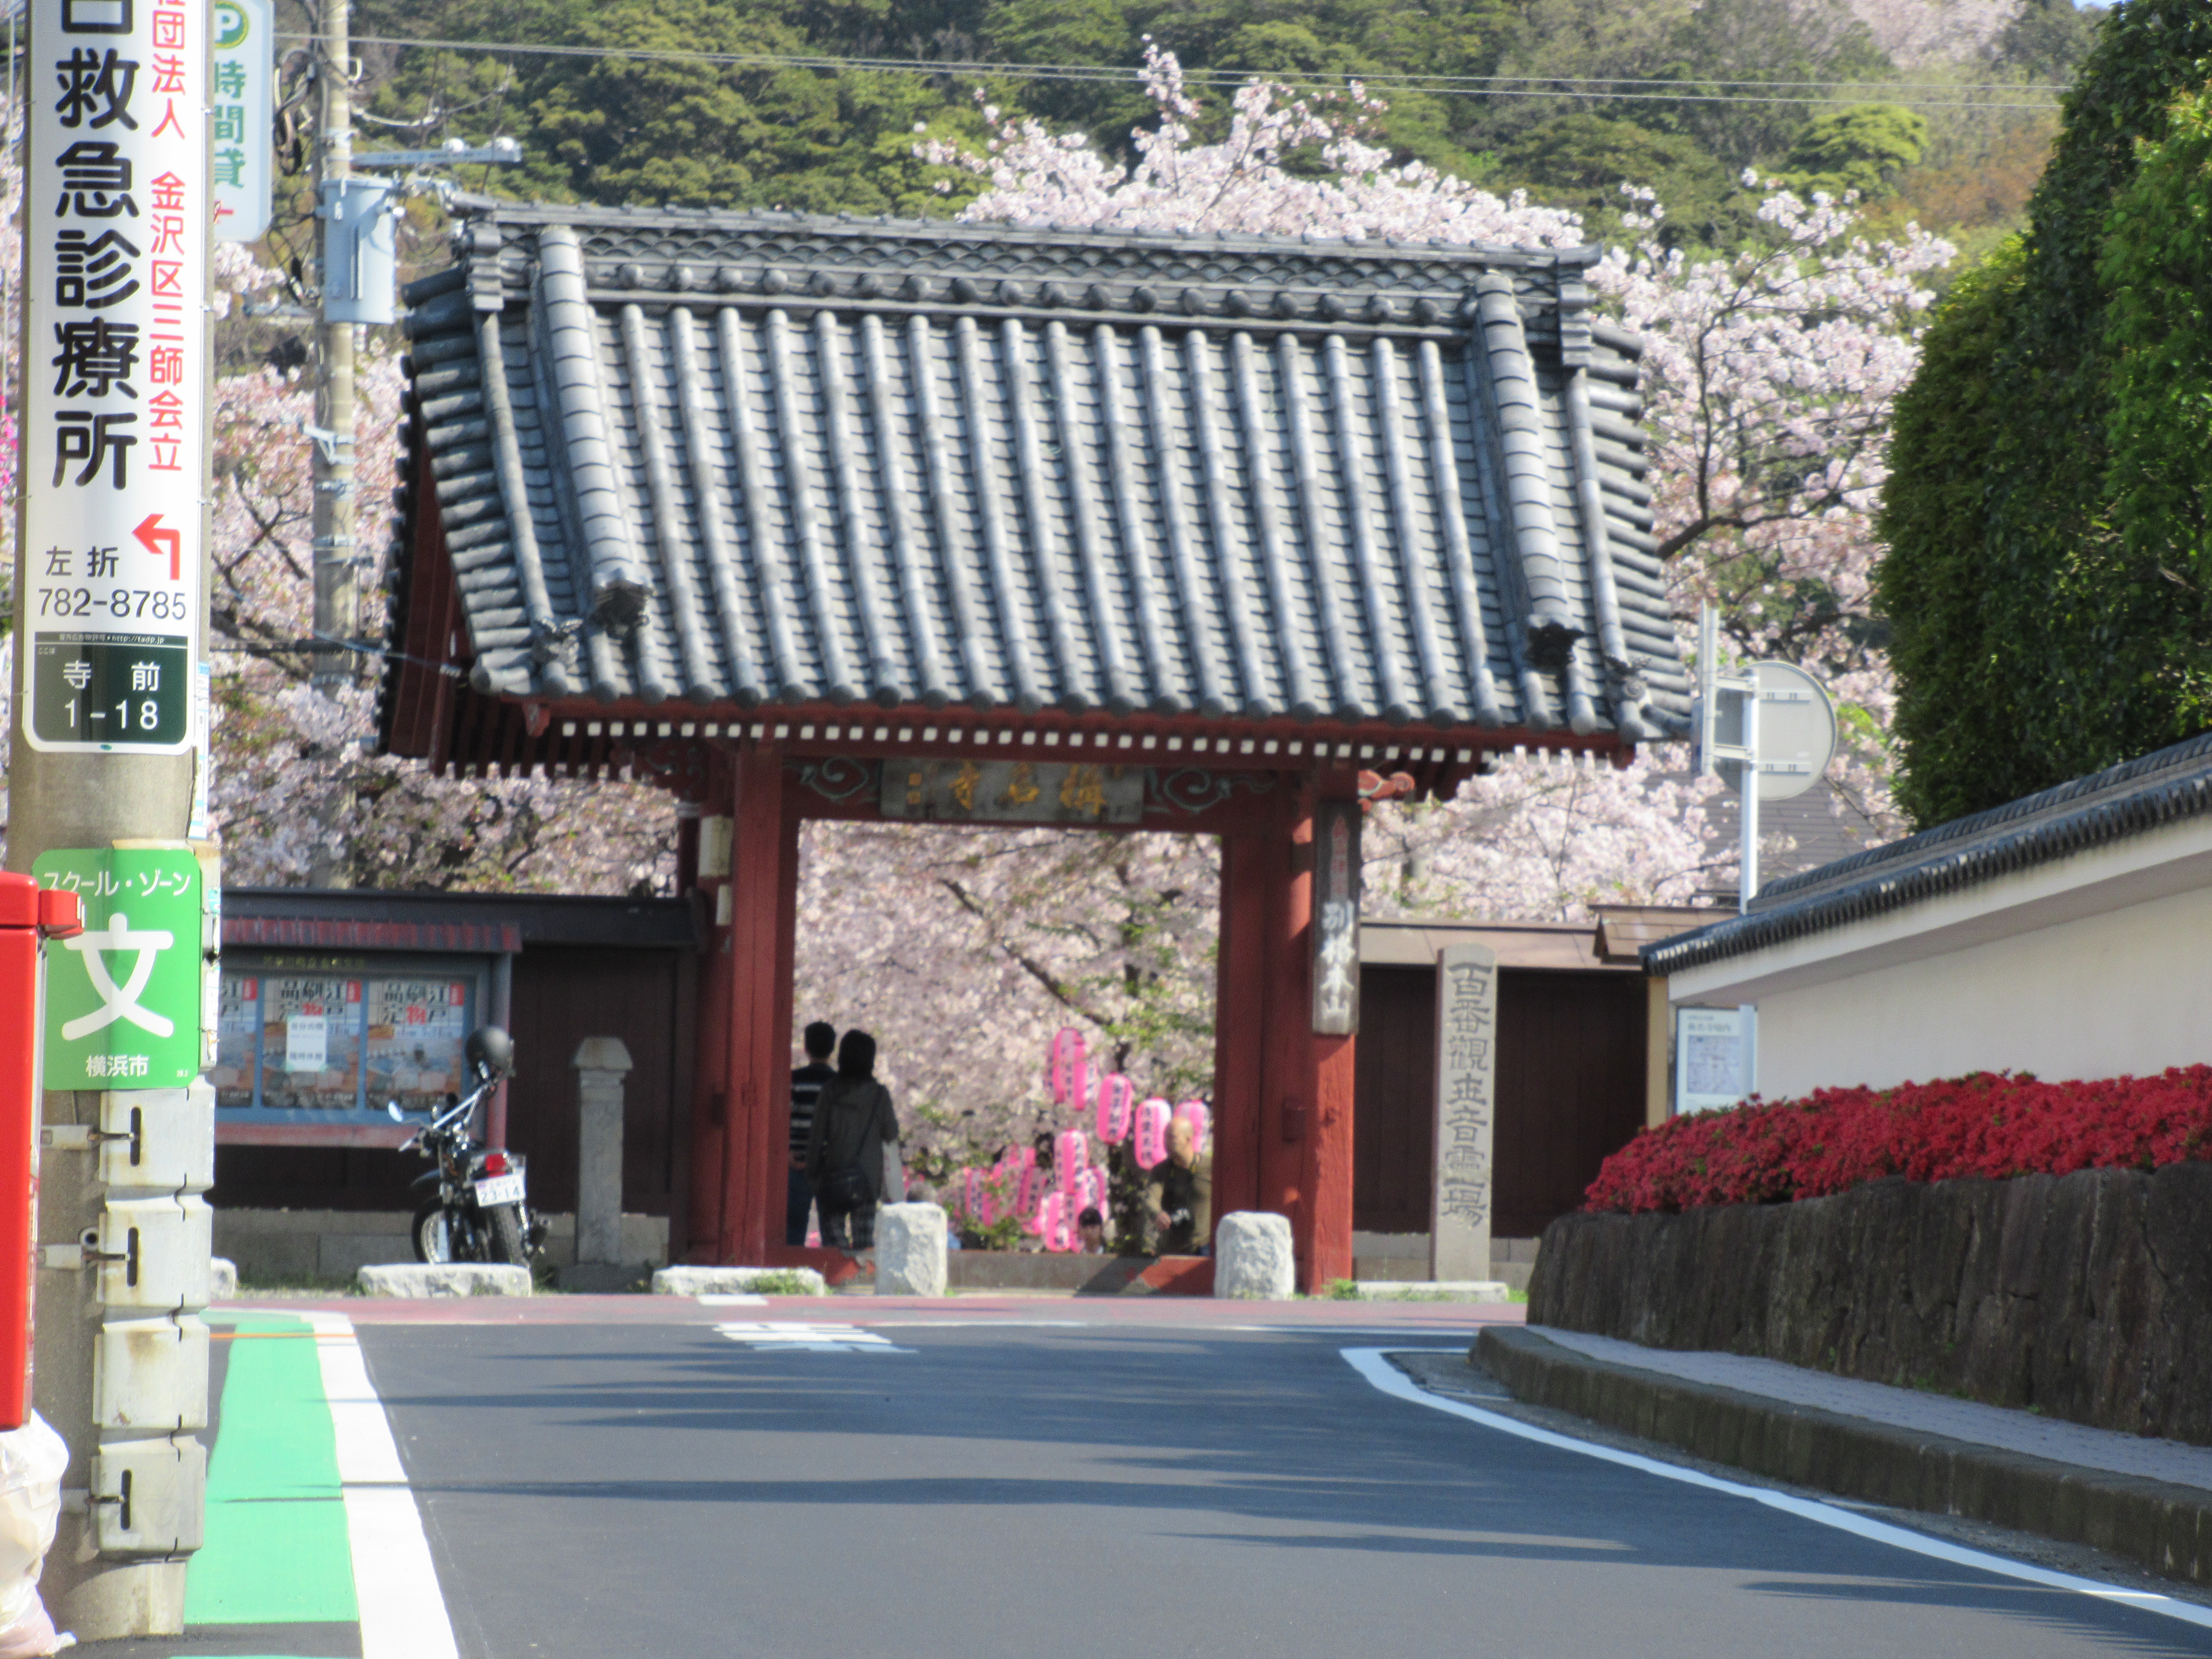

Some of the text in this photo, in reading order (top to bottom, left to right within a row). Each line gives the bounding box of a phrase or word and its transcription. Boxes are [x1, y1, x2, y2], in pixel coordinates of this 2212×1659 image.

[148, 0, 186, 471] 団法人 金沢区三師会立
[46, 546, 119, 578] 左折
[39, 588, 186, 620] 782-8785
[63, 660, 160, 692] 寺前
[64, 699, 158, 730] 1-18
[44, 869, 191, 896] スクール・ゾーン
[62, 913, 174, 1040] 文
[86, 1054, 149, 1077] 横浜市
